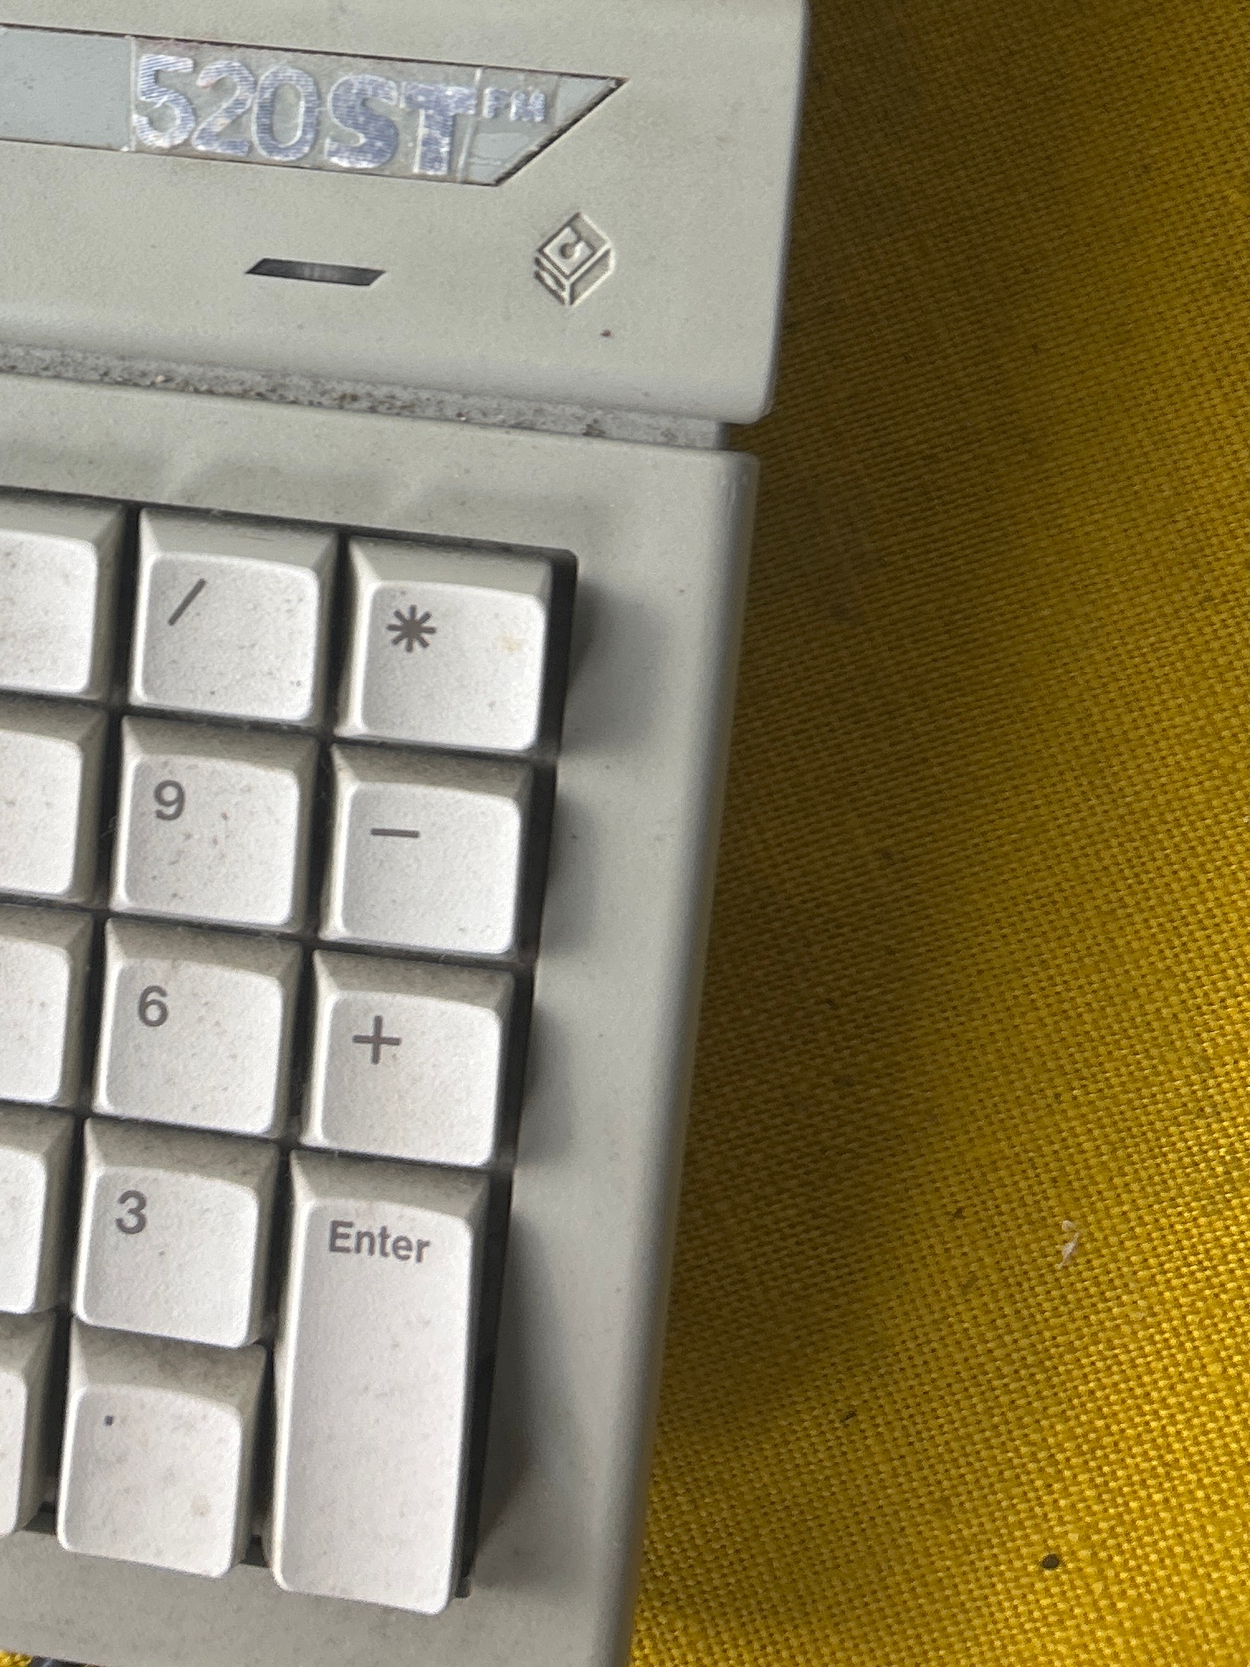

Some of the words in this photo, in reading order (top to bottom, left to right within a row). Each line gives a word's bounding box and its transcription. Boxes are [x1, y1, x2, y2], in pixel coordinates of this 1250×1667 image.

[153, 780, 185, 821] 9
[138, 986, 168, 1027] 6
[352, 1016, 401, 1064] +
[116, 1190, 146, 1235] 3
[328, 1219, 430, 1262] Enter
